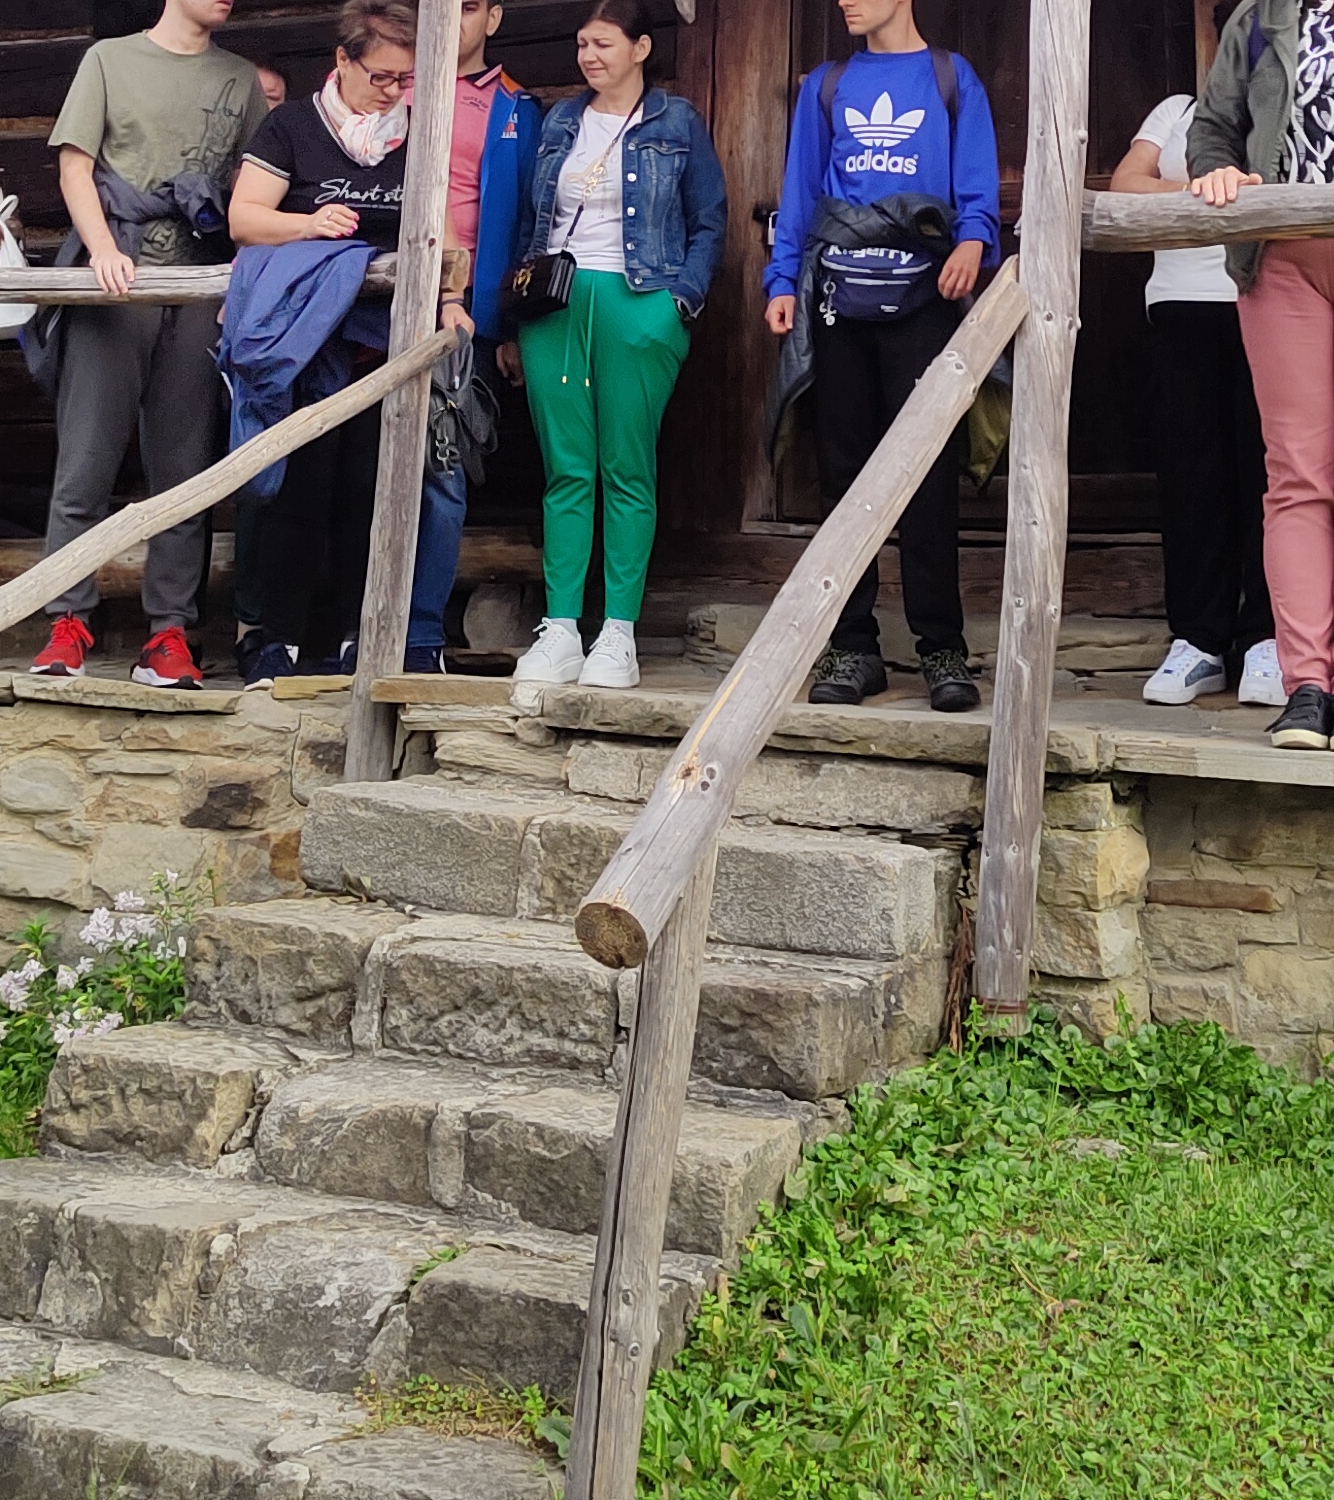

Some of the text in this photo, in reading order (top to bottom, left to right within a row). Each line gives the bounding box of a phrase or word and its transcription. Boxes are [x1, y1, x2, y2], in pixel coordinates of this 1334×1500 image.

[845, 150, 917, 176] adidas
[314, 178, 404, 204] Short st
